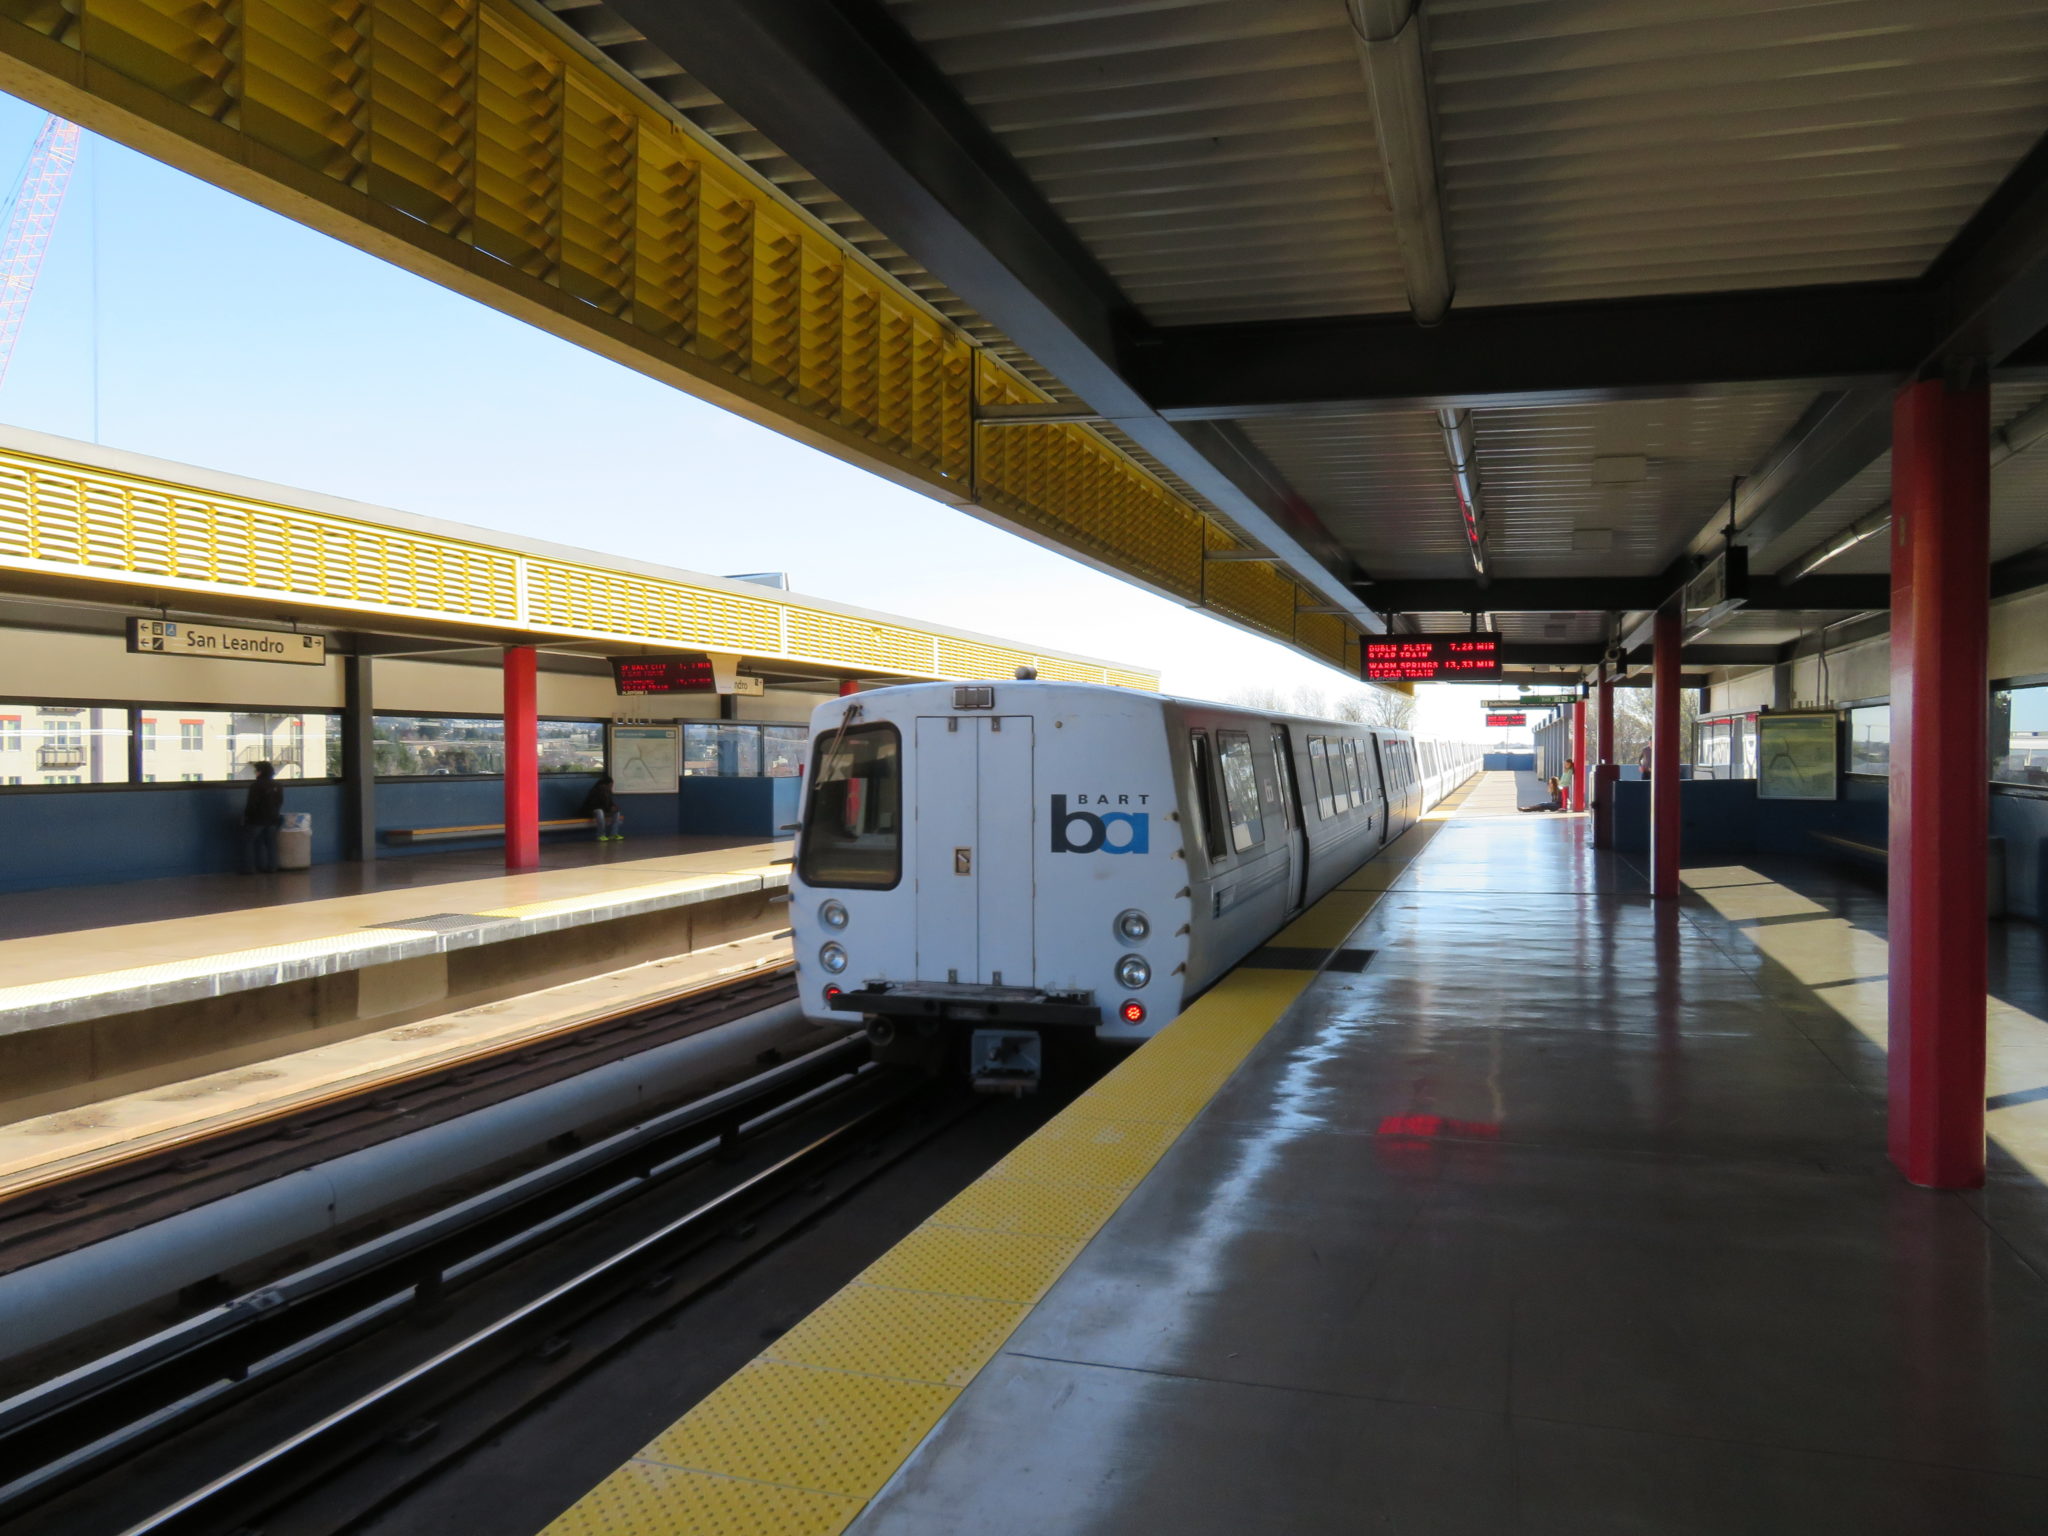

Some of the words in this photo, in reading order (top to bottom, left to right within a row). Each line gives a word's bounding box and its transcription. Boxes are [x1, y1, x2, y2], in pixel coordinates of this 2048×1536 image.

[187, 631, 216, 648] San
[223, 634, 284, 654] Leandro
[1476, 642, 1495, 650] MIN
[1400, 661, 1439, 669] SPRINGS
[1476, 660, 1495, 668] MIN
[1405, 669, 1434, 677] TRAIN
[1078, 794, 1149, 805] BART
